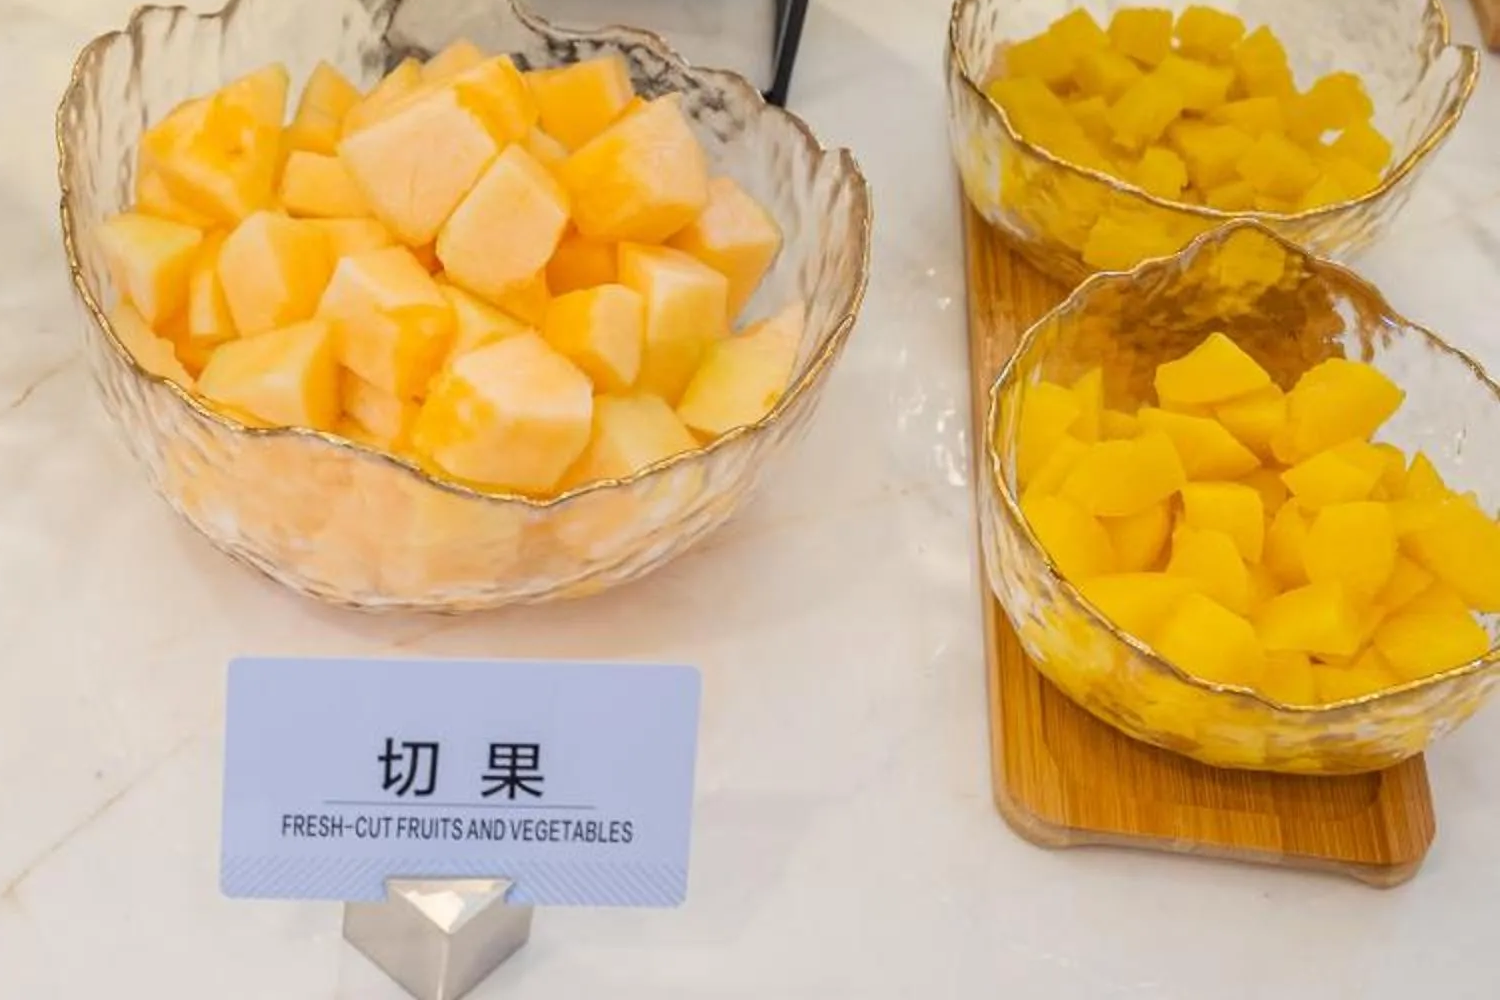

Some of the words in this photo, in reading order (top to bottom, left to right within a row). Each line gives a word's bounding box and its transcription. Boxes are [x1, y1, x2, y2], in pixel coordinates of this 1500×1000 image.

[377, 737, 545, 799] 切果
[281, 814, 393, 841] FRESH-CUT
[397, 816, 463, 842] FRUITS
[466, 818, 506, 842] AND
[510, 818, 634, 844] VEGETABLES
